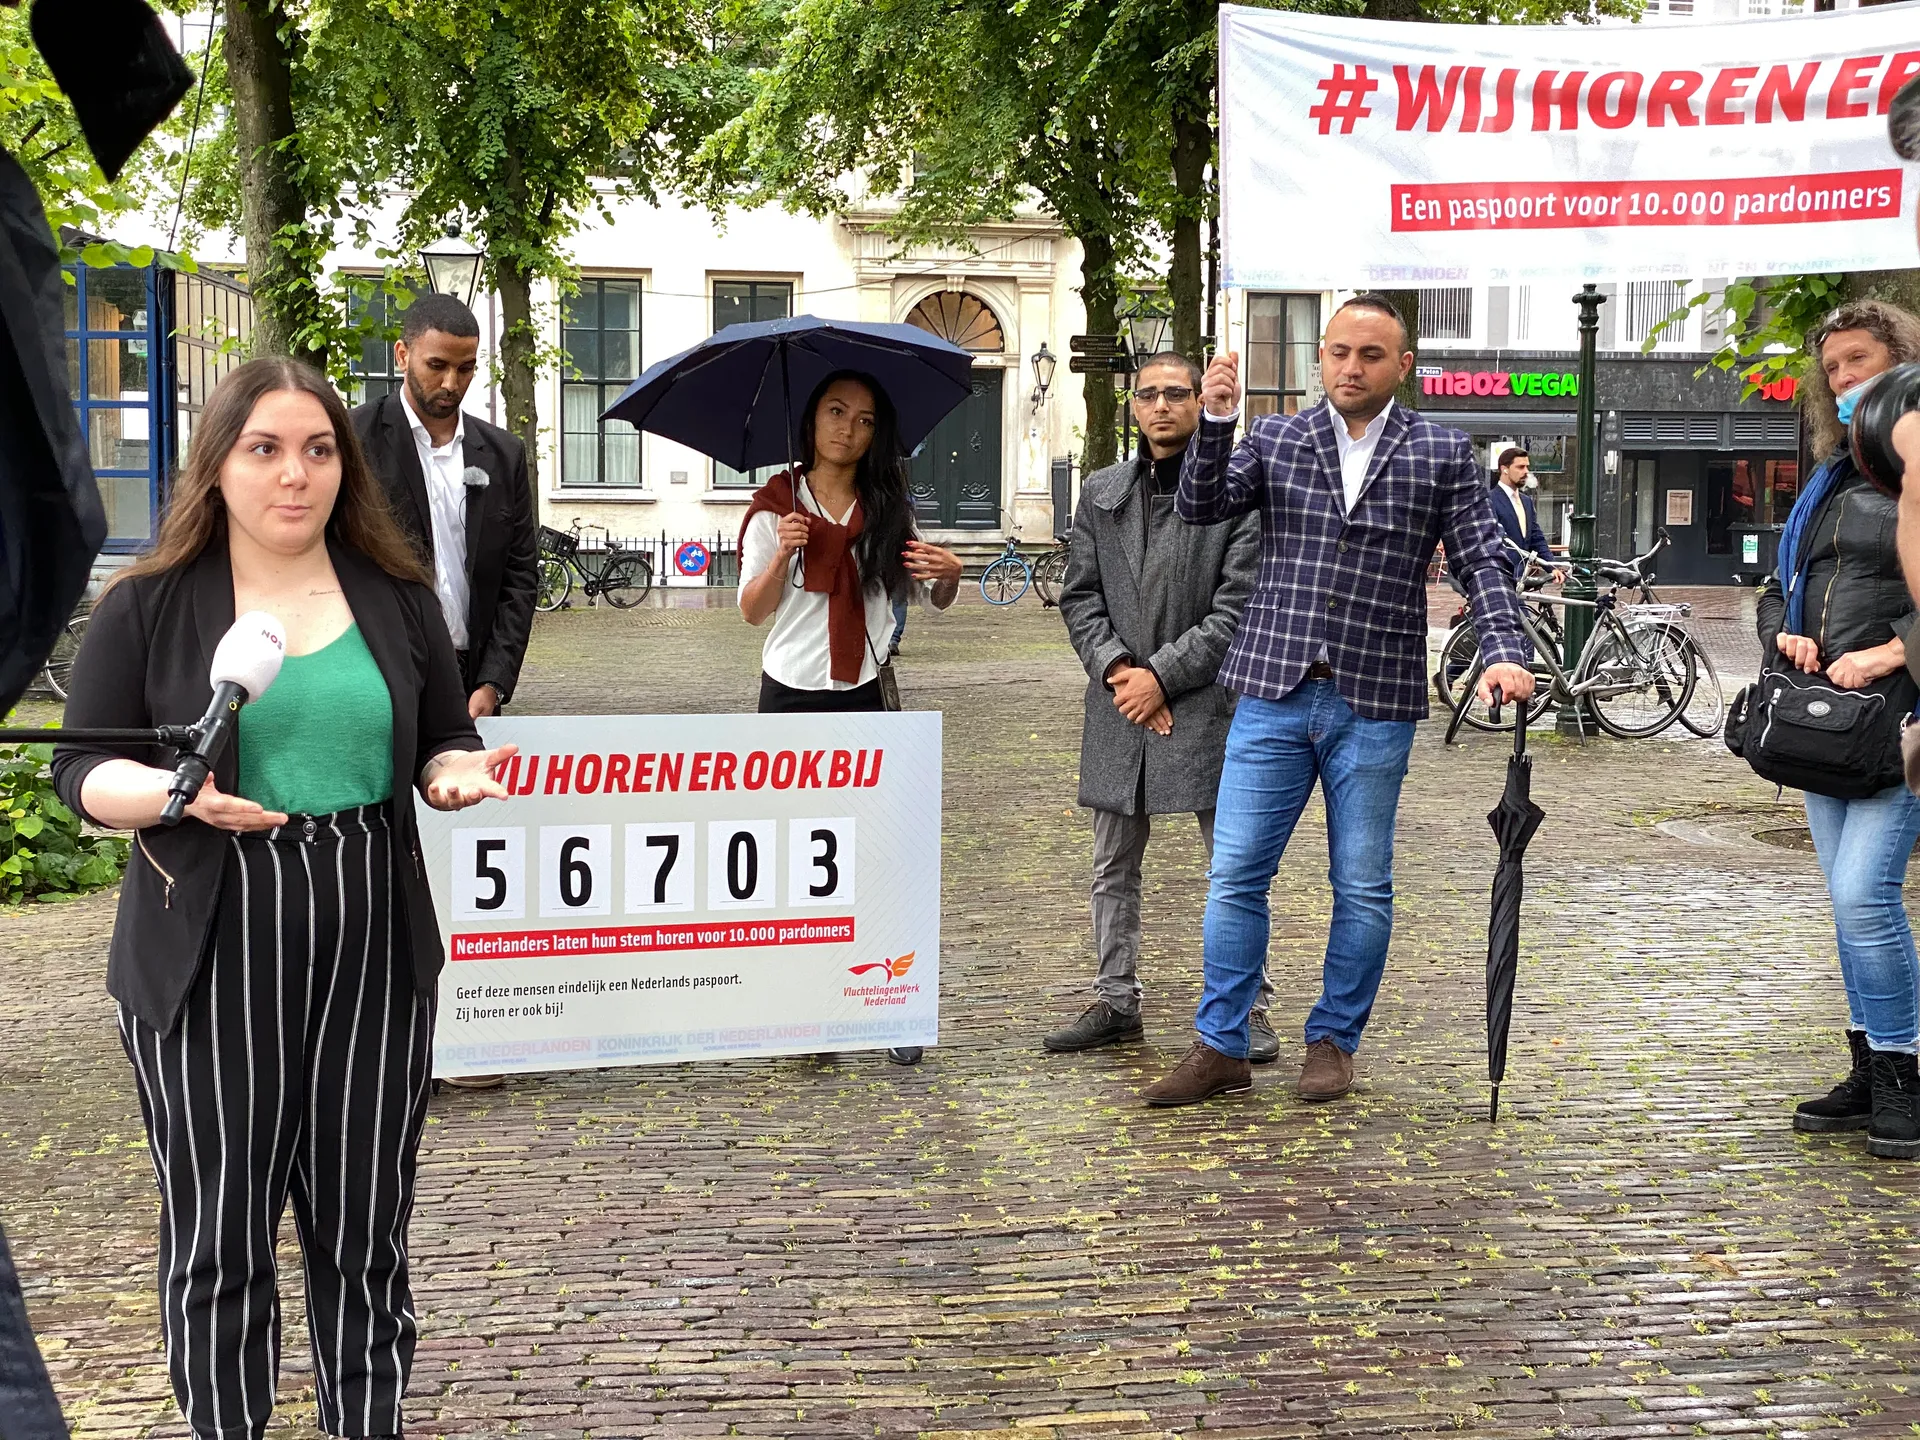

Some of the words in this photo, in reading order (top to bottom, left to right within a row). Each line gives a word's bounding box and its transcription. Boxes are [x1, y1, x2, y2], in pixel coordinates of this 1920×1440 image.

[1530, 61, 1822, 132] HOREN
[1401, 193, 1442, 221] Een
[1449, 192, 1557, 226] paspoort
[1563, 194, 1623, 216] voor
[1628, 191, 1726, 216] 10.000
[1733, 185, 1892, 221] pardonners
[1346, 264, 1469, 282] DERLANDEN
[1510, 373, 1580, 397] VEGA
[543, 752, 685, 795] HOREN
[688, 751, 738, 792] ER
[743, 750, 827, 791] OOK
[828, 748, 884, 789] BIJ
[456, 935, 550, 955] Nederlanders
[552, 934, 588, 951] laten
[592, 933, 617, 949] hun
[620, 932, 652, 948] stem
[656, 930, 694, 946] horen
[697, 930, 726, 944] voor
[729, 926, 775, 942] 10.000
[778, 923, 851, 943] pardonners
[456, 986, 483, 999] Geef
[485, 985, 510, 998] deze
[513, 985, 555, 996] mensen
[558, 980, 606, 995] eindelijk
[609, 981, 628, 991] een
[631, 975, 691, 990] Nederlands
[693, 973, 742, 989] paspoort.
[843, 983, 920, 997] VluchtelingenWerk
[456, 1007, 470, 1023] Zij
[473, 1006, 505, 1019] horen
[508, 1007, 520, 1017] er
[522, 1003, 542, 1016] ook
[545, 1002, 564, 1018] bij!
[863, 995, 907, 1007] Nederland
[445, 1046, 477, 1060] DER
[481, 1038, 591, 1058] NEDERLANDEN
[598, 1034, 683, 1051] KONINKRIJK
[686, 1031, 715, 1046] DER
[719, 1025, 821, 1043] NEDERLANDEN
[826, 1020, 906, 1037] KONINKRIJK
[909, 1018, 936, 1031] DER
